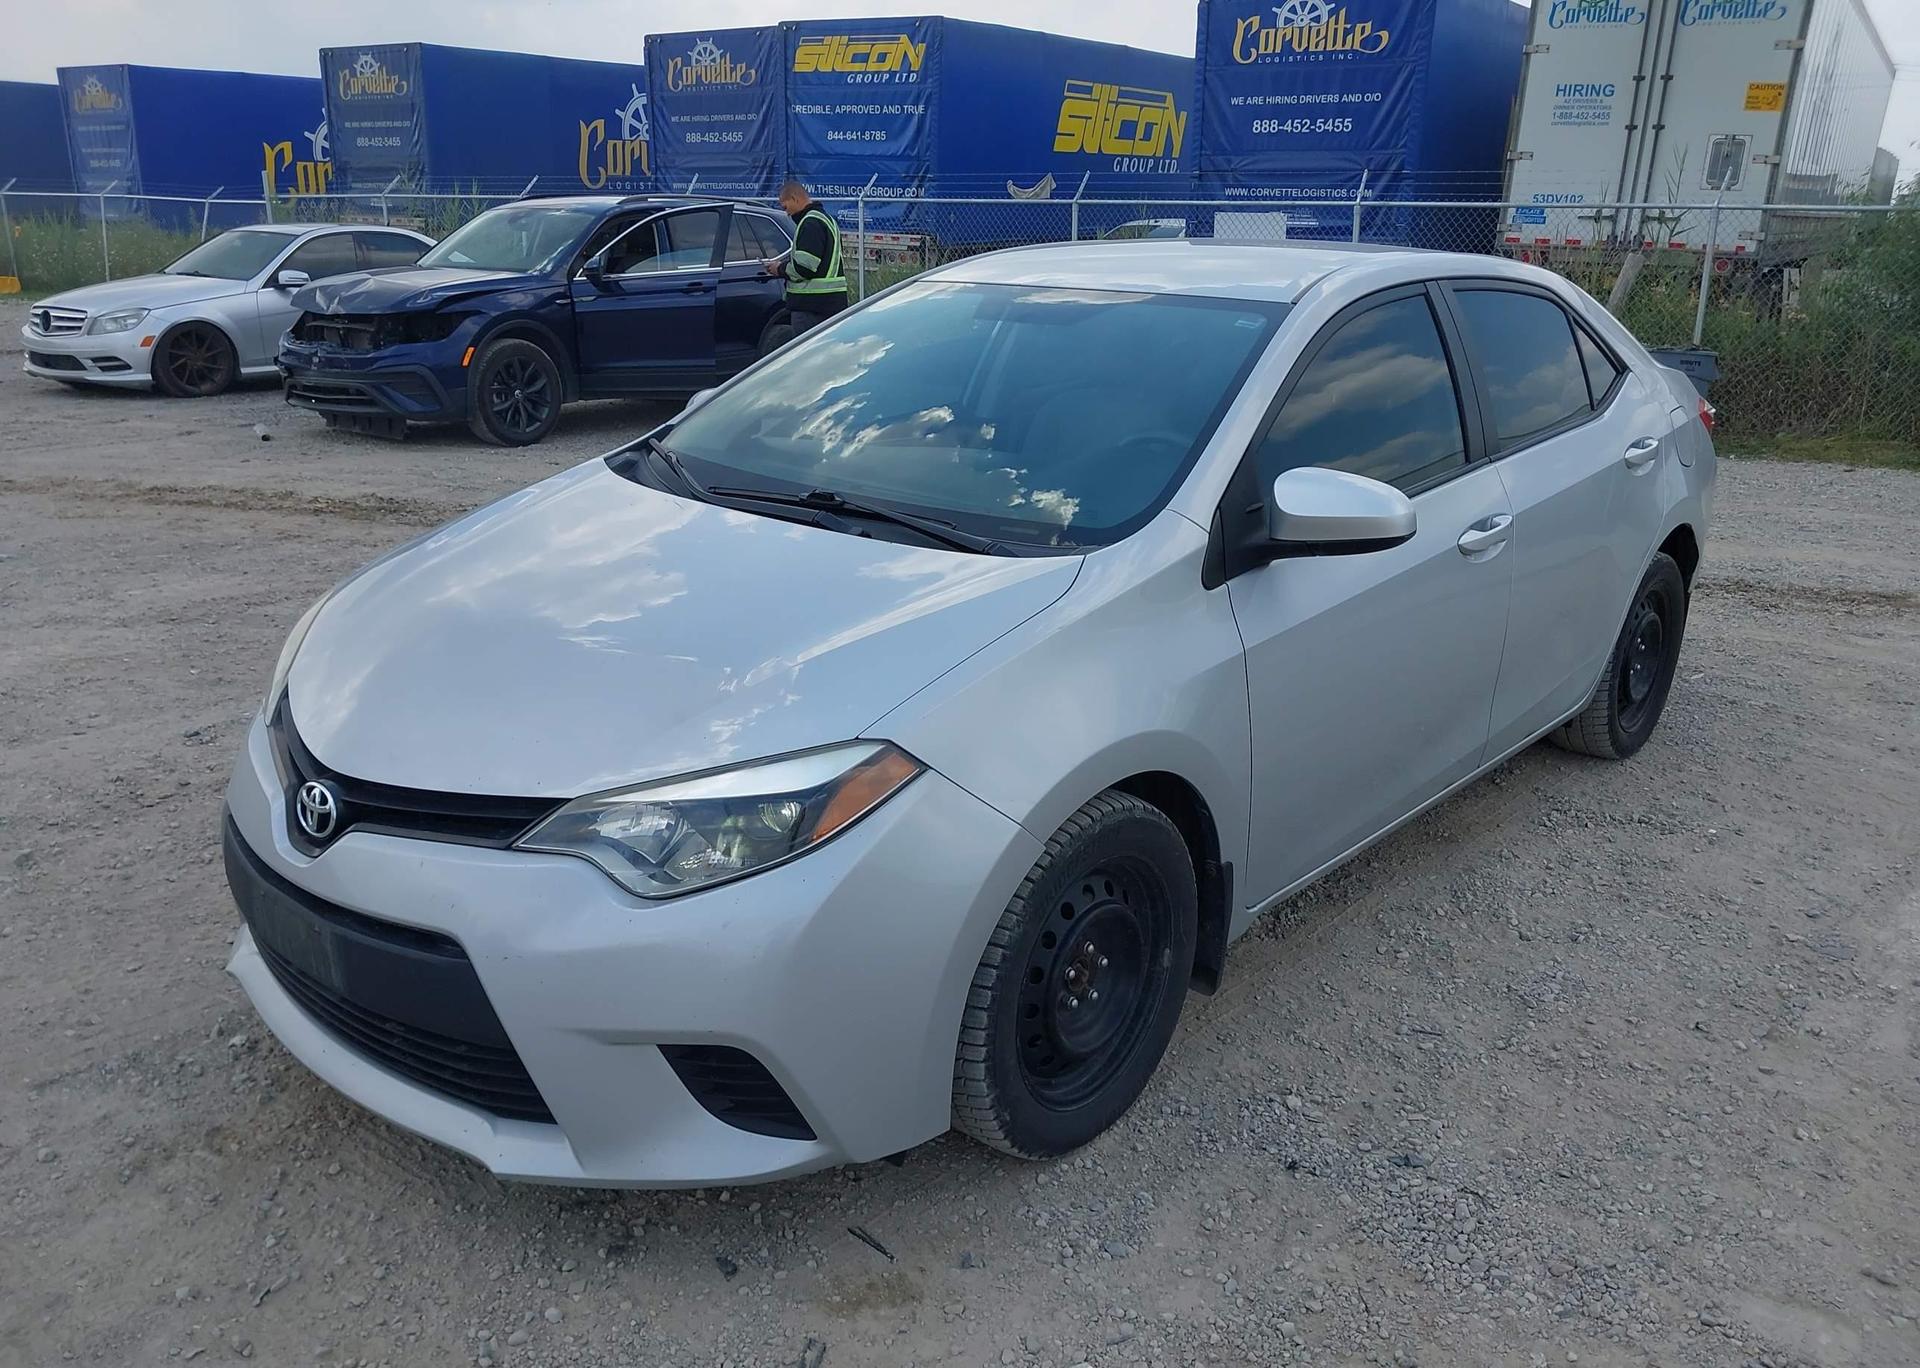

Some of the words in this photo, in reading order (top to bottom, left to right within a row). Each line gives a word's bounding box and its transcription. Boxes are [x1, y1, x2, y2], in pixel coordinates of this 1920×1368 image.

[1548, 0, 1645, 30] Corvette
[1232, 7, 1389, 64] Corvette
[1258, 55, 1324, 64] LOGISTICS
[1332, 53, 1360, 61] INC.
[667, 52, 756, 92] Corvette
[847, 73, 889, 84] GROUP
[338, 65, 408, 101] Corvette
[1555, 83, 1616, 98] HIRING
[1231, 97, 1245, 106] WE
[1246, 96, 1264, 105] ARE
[1266, 95, 1298, 105] HIRING
[1300, 94, 1340, 104] DRIVERS
[1341, 93, 1362, 103] AND
[835, 104, 880, 114] APPROVED
[882, 104, 901, 114] AND
[903, 104, 925, 115] TRUE
[1252, 118, 1353, 133] 888-452-5455
[685, 131, 744, 143] 888-452-5455
[827, 130, 887, 141] 844-641-8785
[1113, 157, 1154, 173] GROUP
[1157, 159, 1181, 173] LTD.
[1225, 187, 1373, 198] WWW.CORVETTELOGISTICS.COM
[1532, 194, 1584, 204] 53DV102
